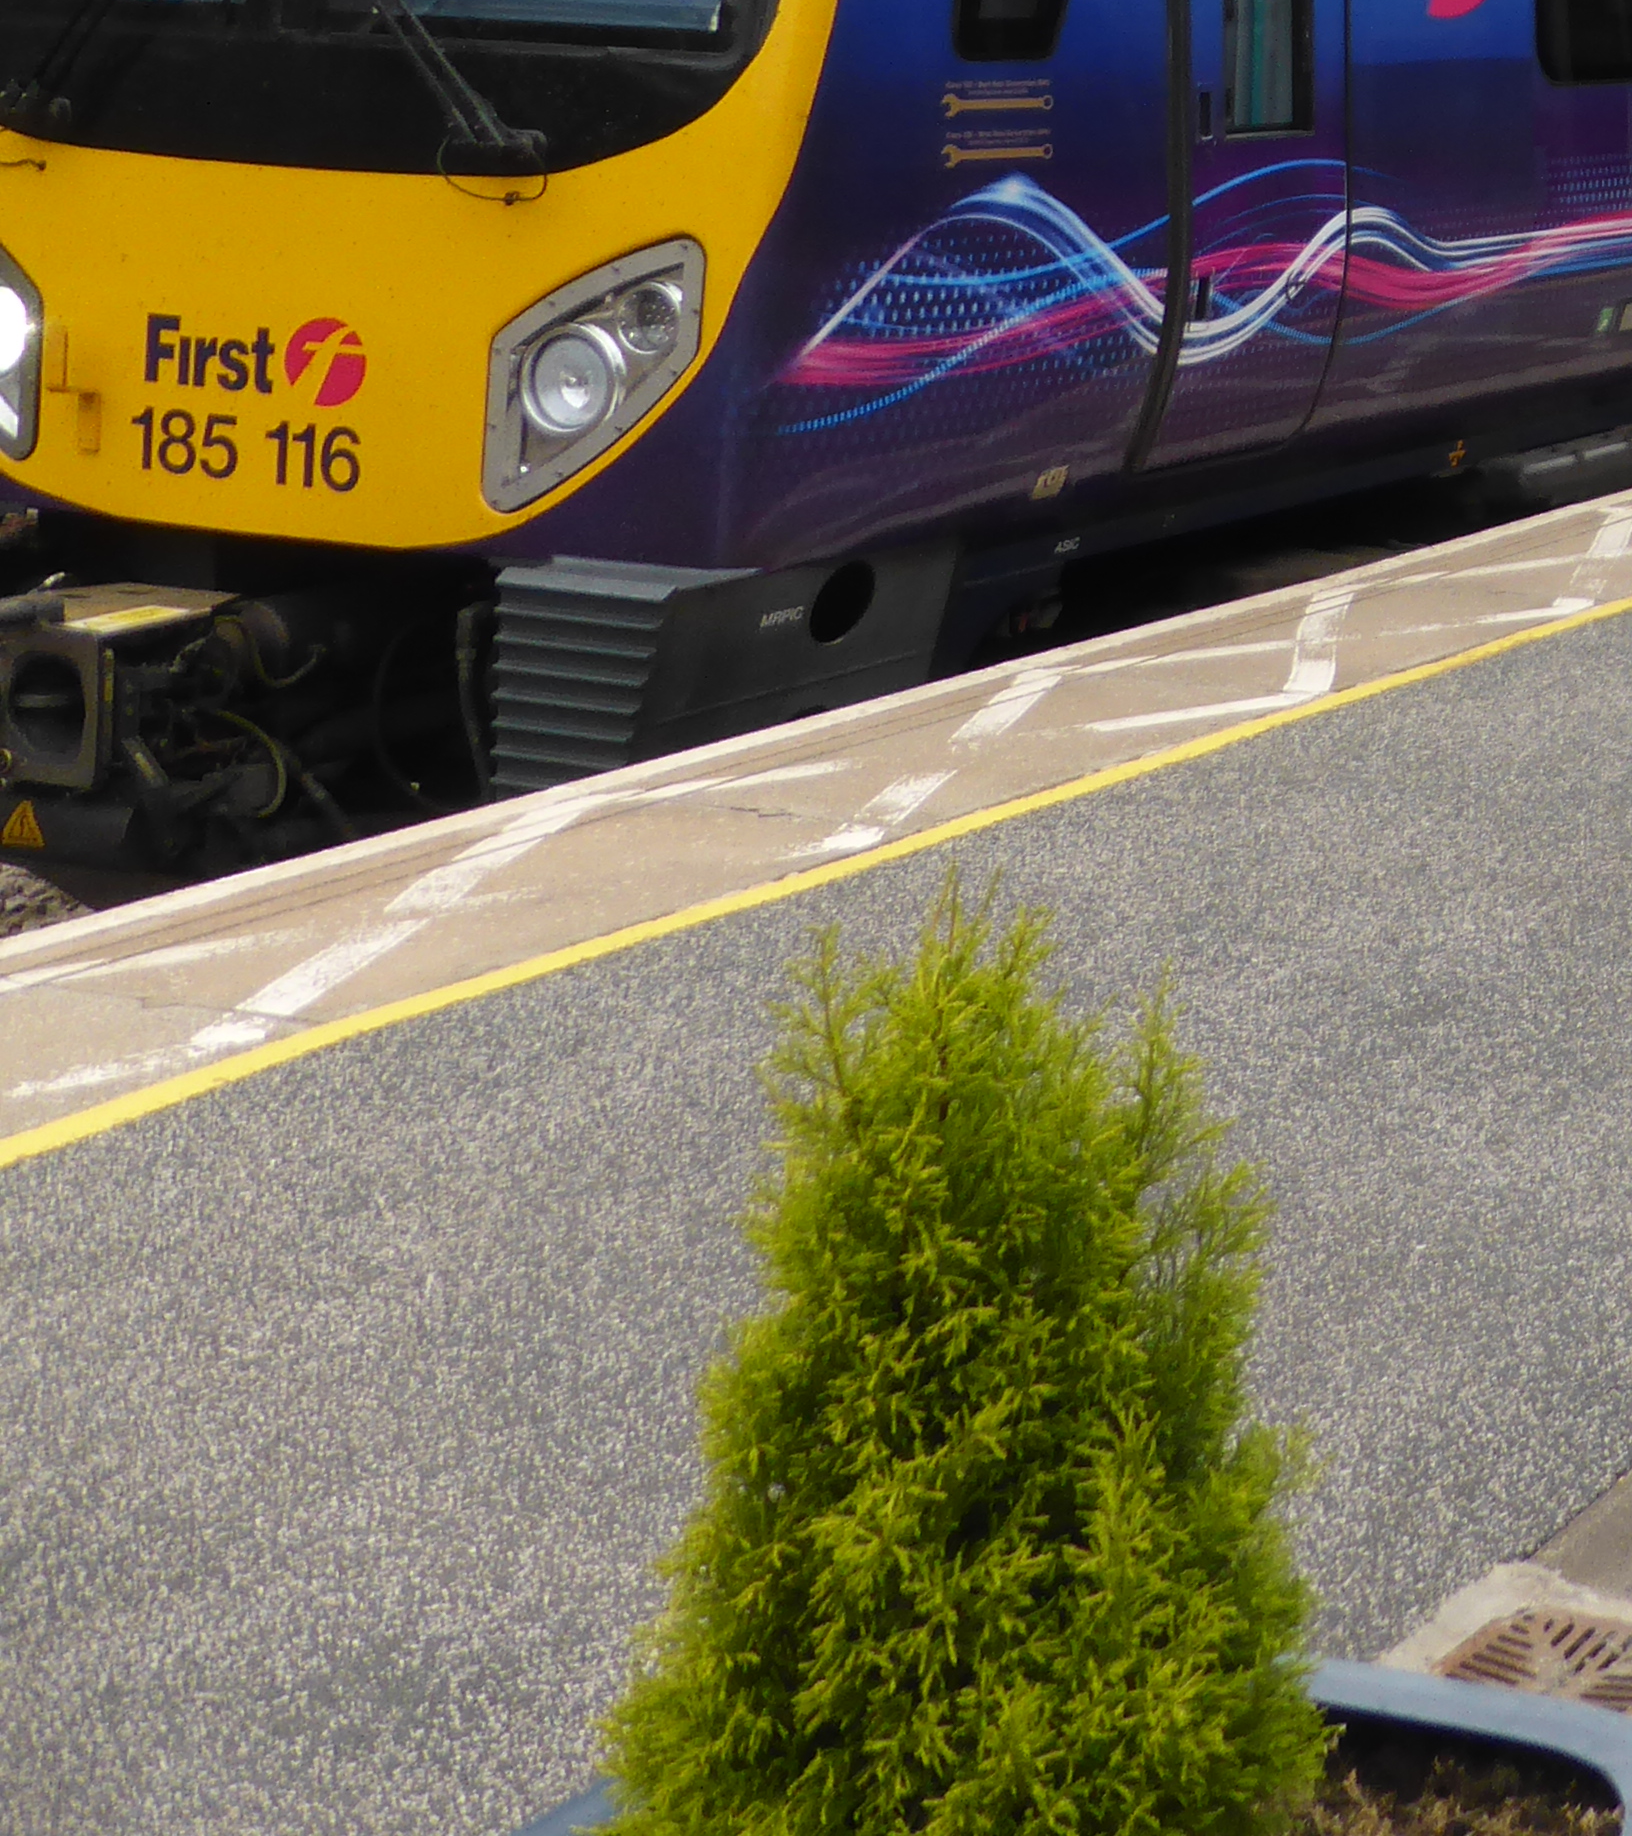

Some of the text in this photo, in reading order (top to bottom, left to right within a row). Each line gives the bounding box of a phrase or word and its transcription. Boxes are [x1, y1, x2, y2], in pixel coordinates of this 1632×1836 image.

[144, 311, 276, 396] First
[131, 405, 361, 494] 185 116
